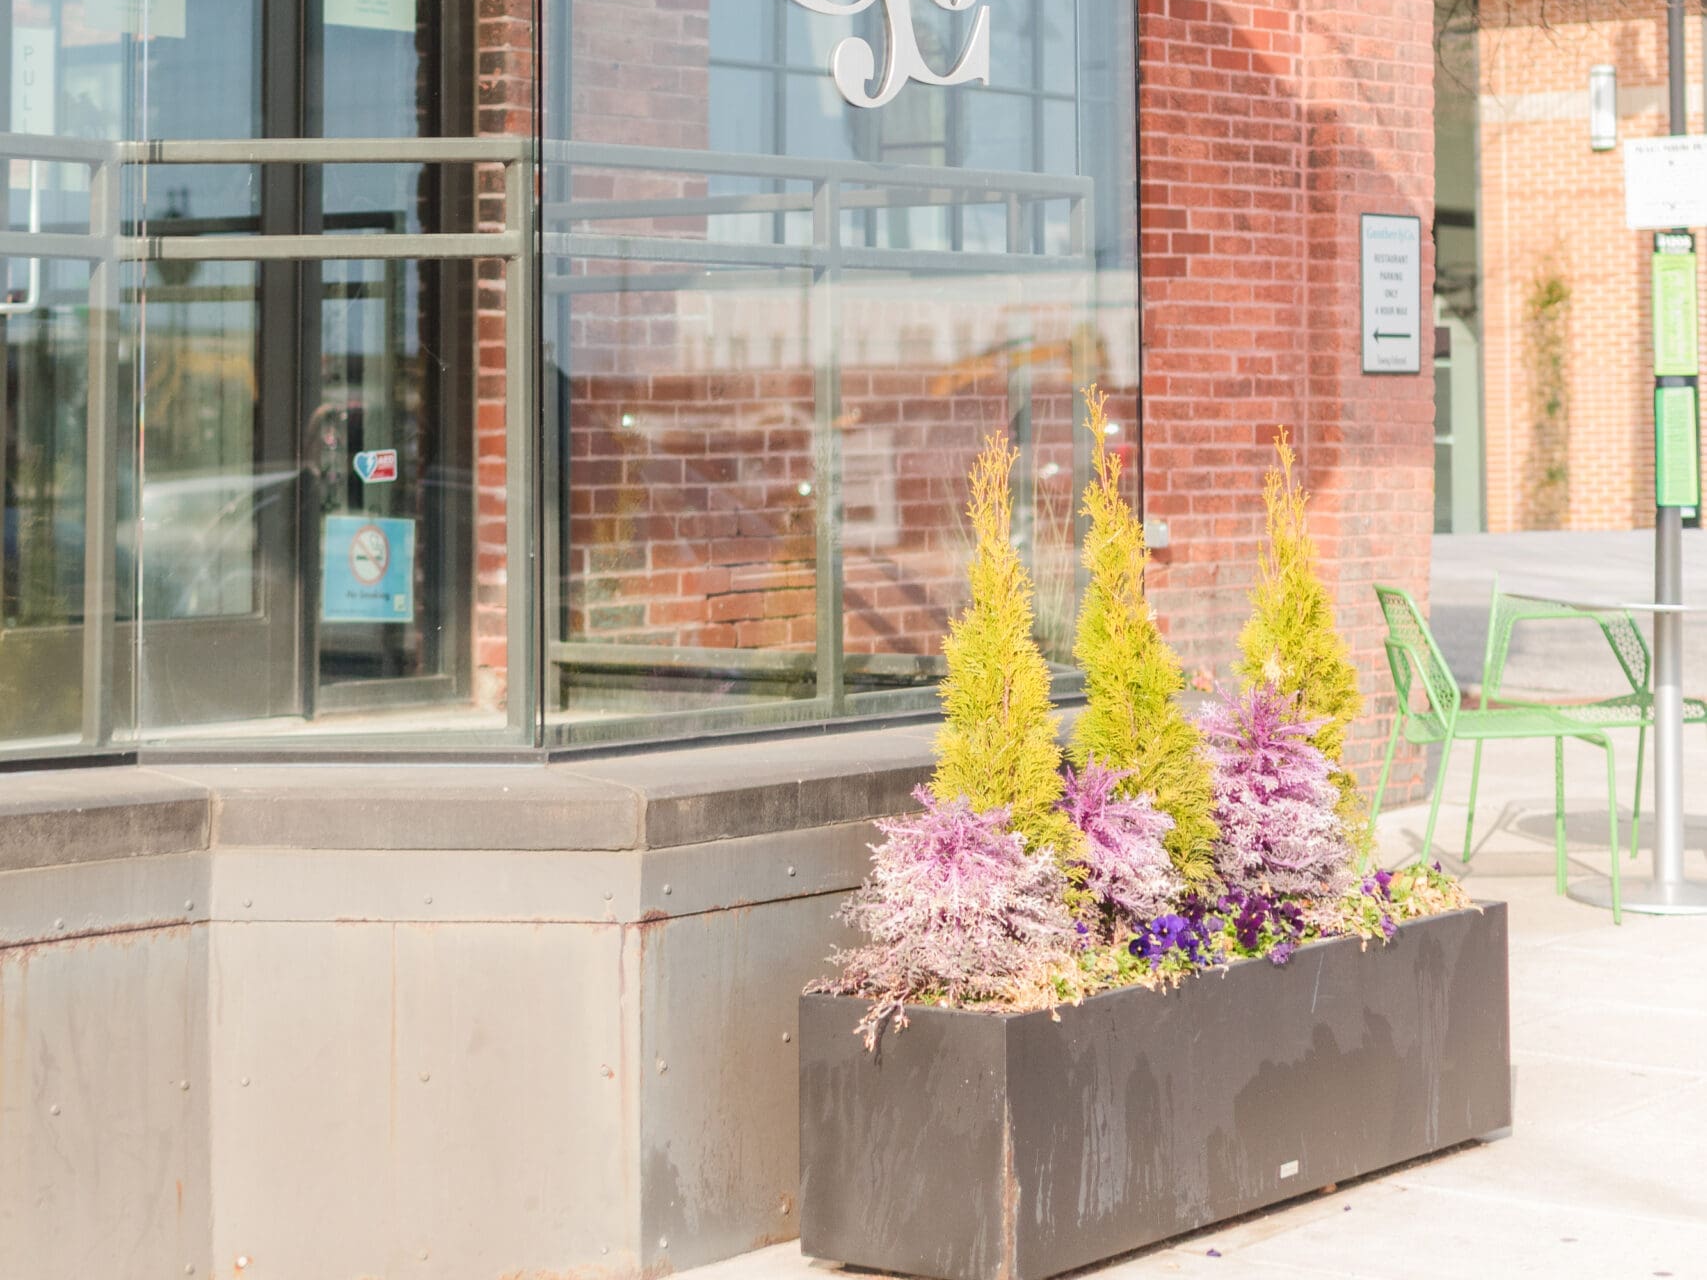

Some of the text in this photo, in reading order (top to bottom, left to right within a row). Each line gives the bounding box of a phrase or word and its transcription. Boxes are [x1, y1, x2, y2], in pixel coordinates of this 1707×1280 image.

[1374, 254, 1408, 264] RESTAURANT
[1380, 272, 1403, 281] PARKING
[1384, 289, 1398, 298] ONLY
